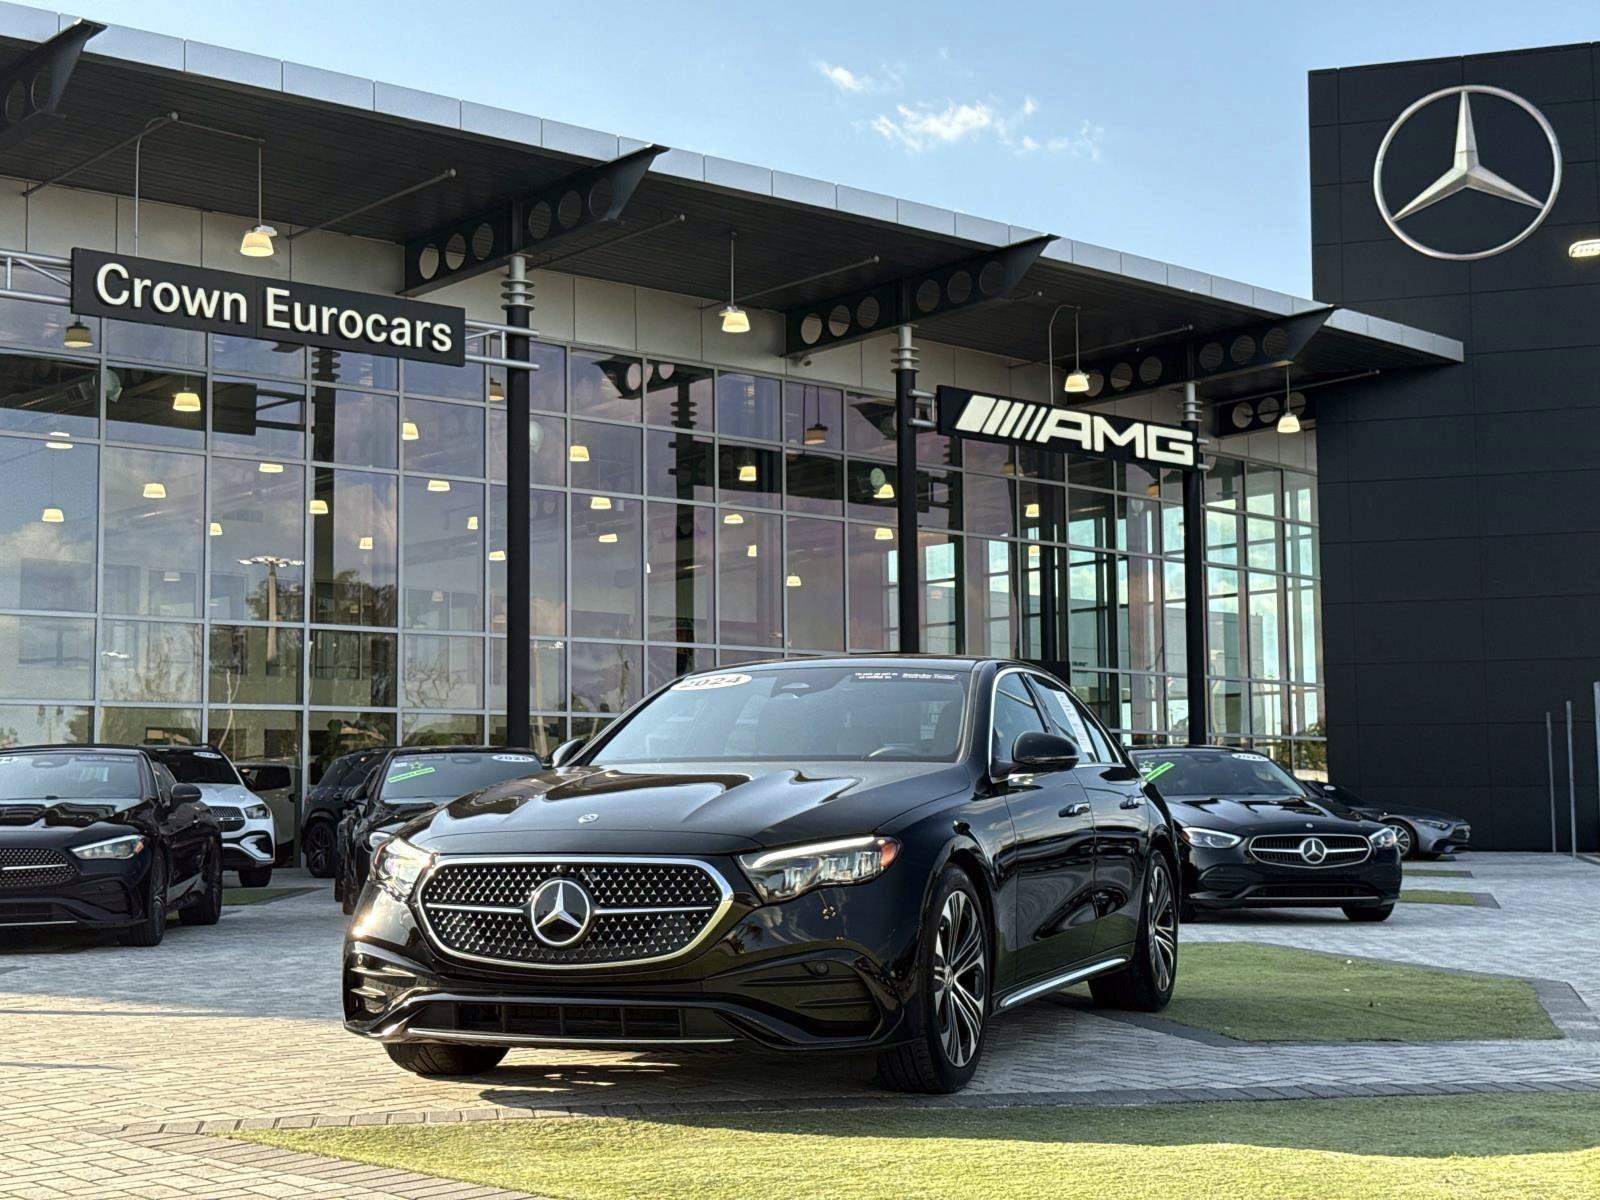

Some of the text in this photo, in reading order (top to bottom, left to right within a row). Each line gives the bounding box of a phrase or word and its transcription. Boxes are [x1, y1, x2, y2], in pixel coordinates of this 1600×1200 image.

[97, 262, 453, 352] Crown Eurocars
[1037, 408, 1194, 466] AMG
[678, 675, 743, 688] 2024
